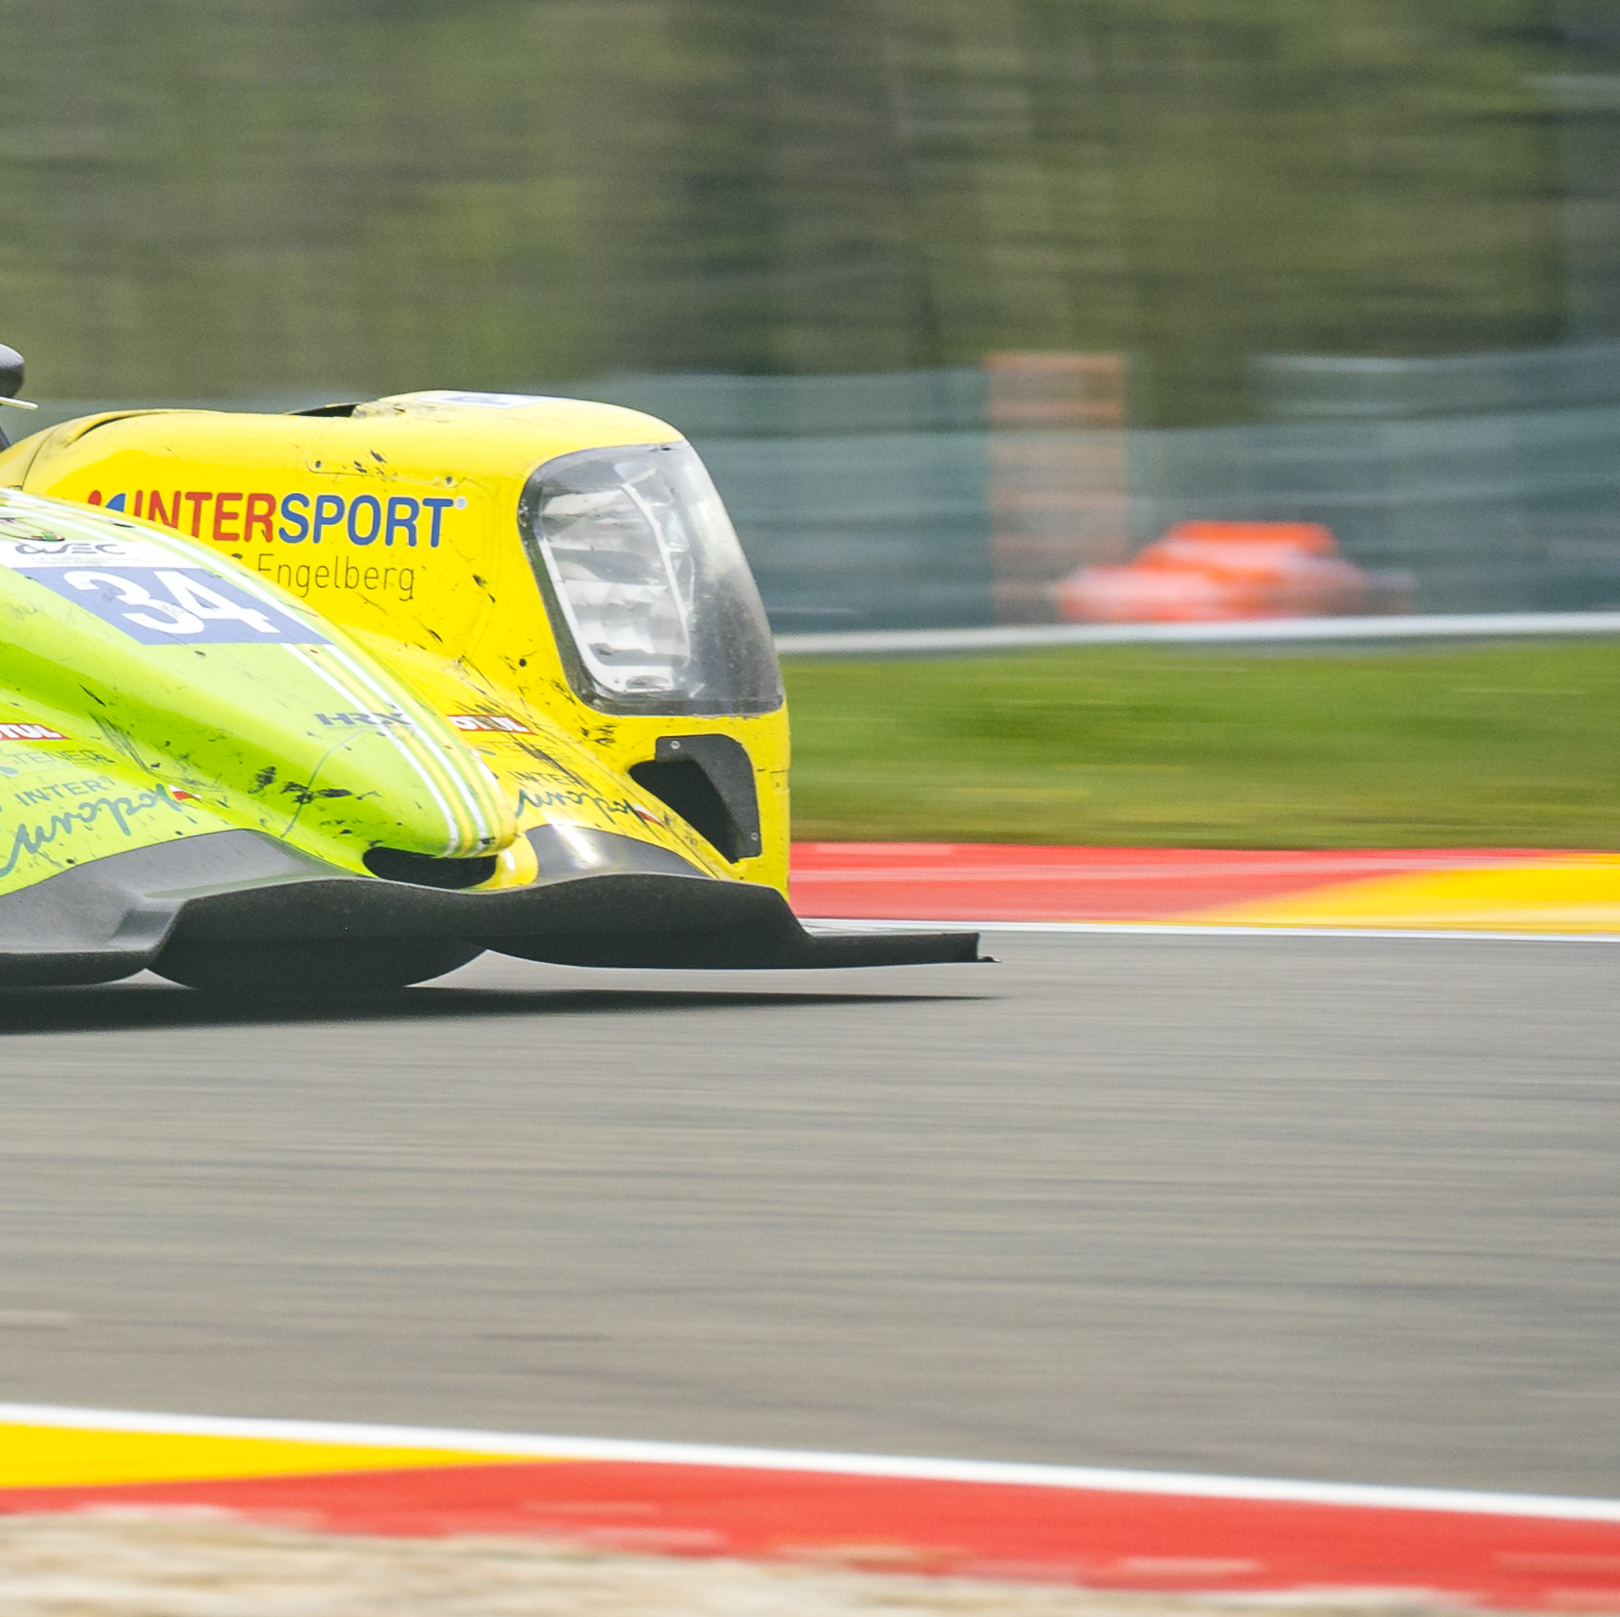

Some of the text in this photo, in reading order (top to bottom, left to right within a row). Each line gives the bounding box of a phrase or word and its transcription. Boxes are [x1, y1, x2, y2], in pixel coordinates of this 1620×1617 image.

[133, 490, 454, 548] INTERSPORT
[63, 570, 281, 634] 34
[258, 553, 415, 601] Engelberg
[15, 777, 109, 807] INTER
